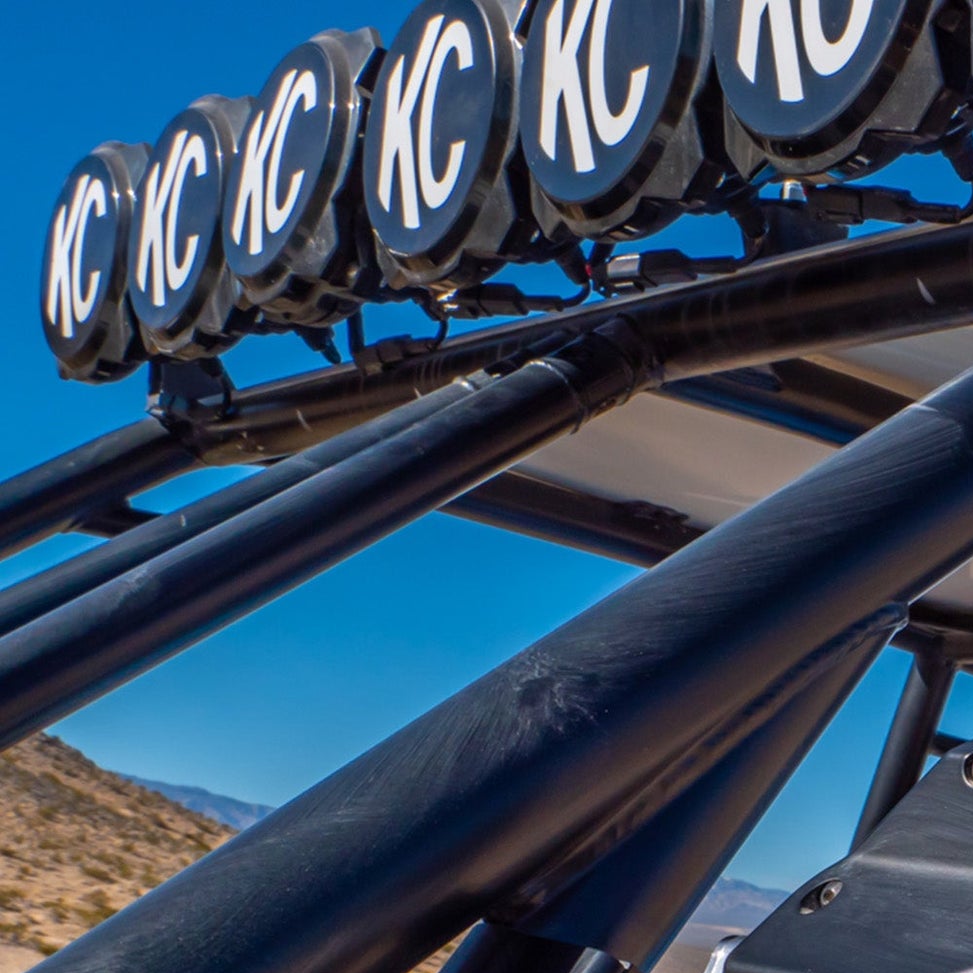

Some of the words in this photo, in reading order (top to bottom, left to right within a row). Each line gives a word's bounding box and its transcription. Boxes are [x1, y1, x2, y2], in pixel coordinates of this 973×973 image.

[231, 69, 317, 255] KC
[378, 14, 473, 229] KC
[539, 0, 650, 172] KC
[47, 174, 106, 338] KC
[136, 130, 207, 306] KC
